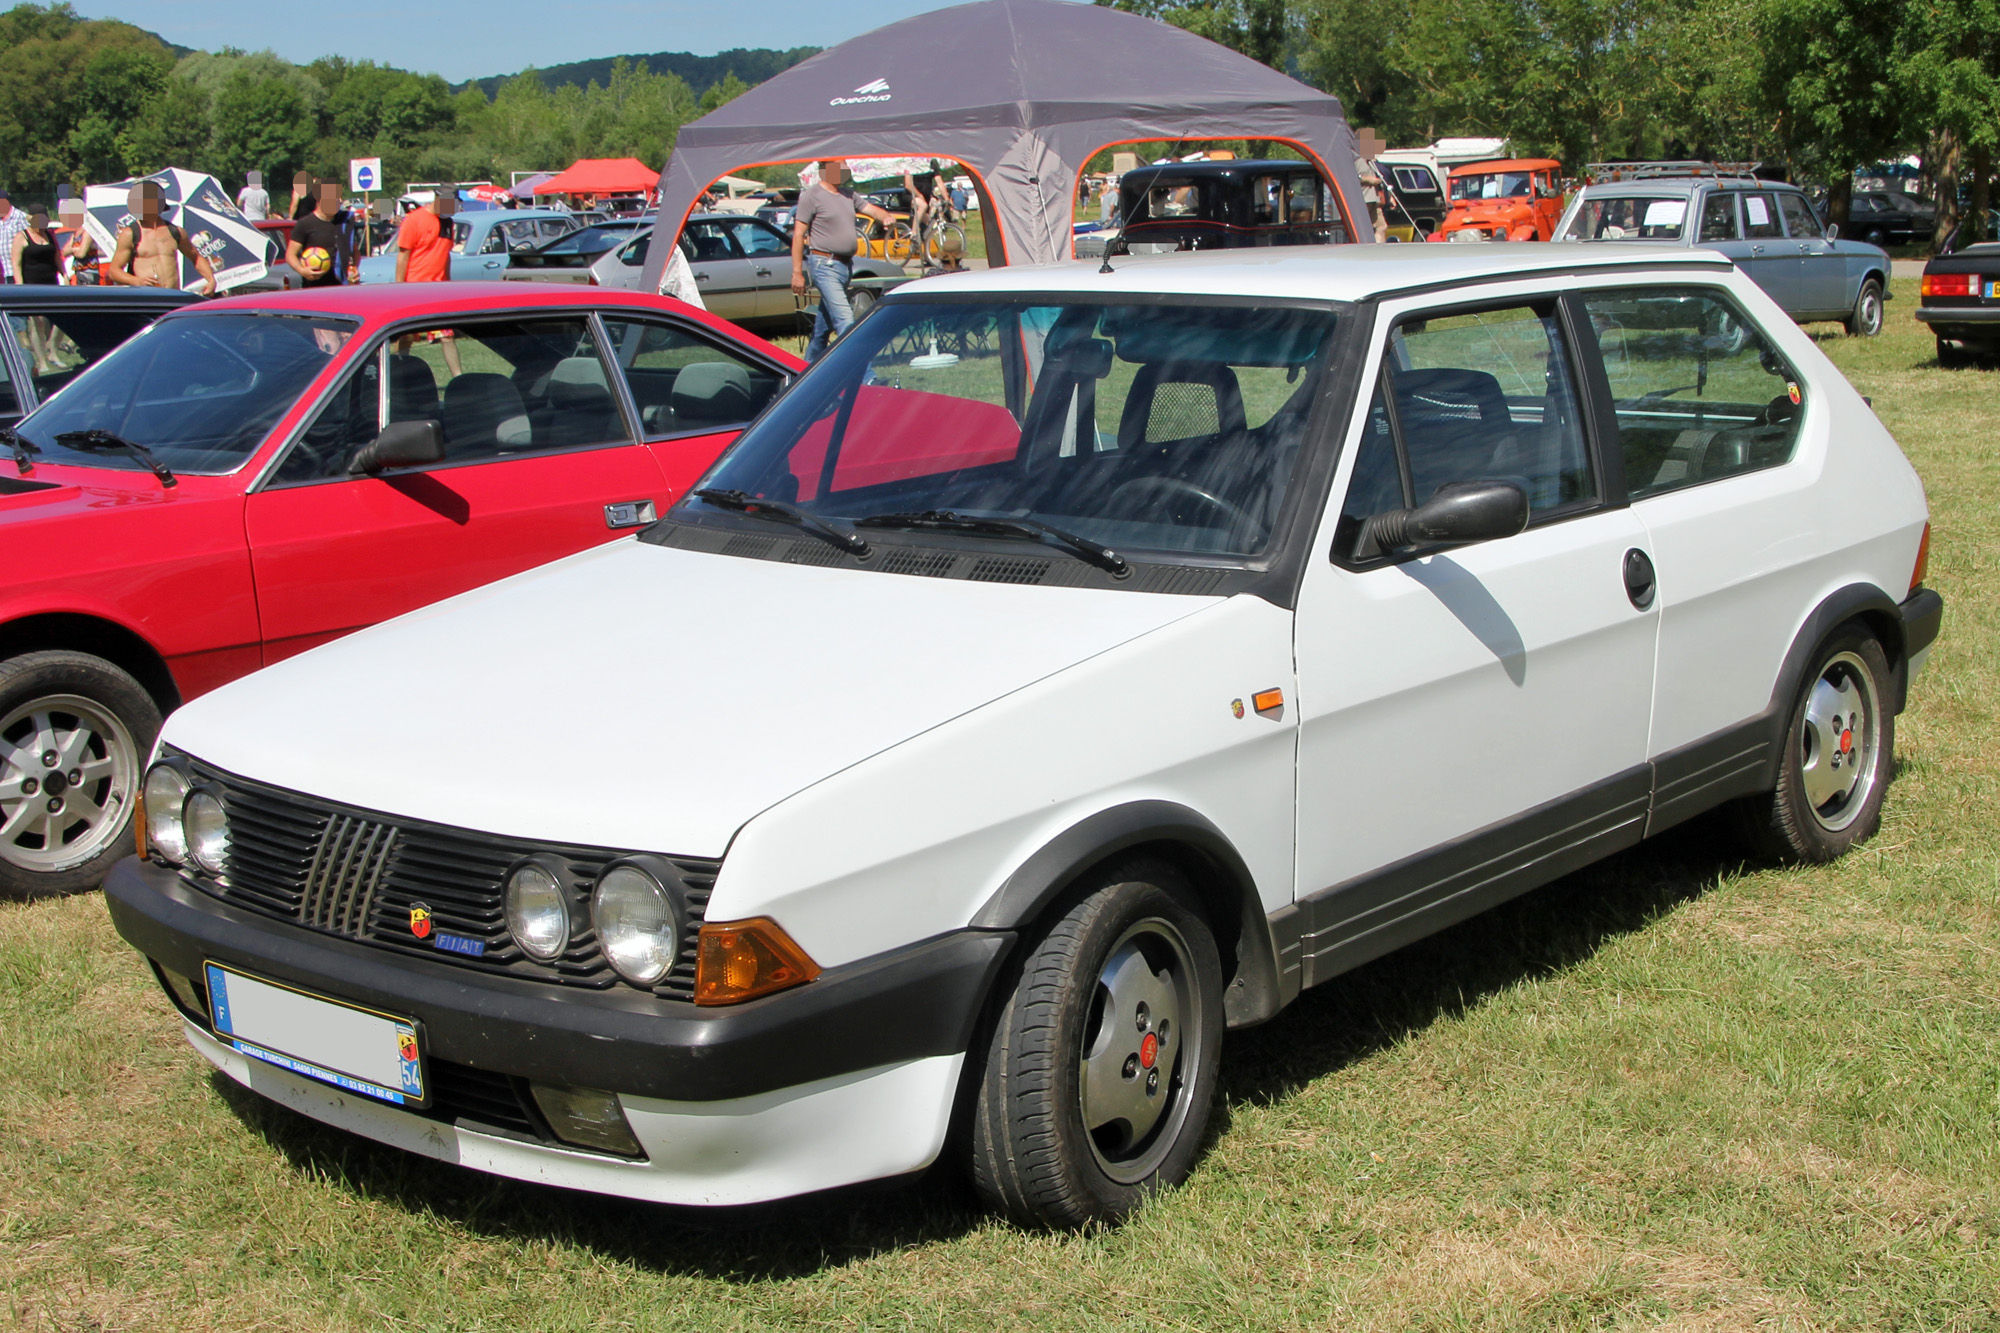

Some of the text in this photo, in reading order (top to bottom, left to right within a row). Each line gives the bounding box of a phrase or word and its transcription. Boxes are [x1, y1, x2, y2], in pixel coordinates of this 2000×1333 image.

[829, 94, 891, 106] Quechua
[438, 935, 482, 953] FIAT
[218, 1005, 225, 1020] F
[240, 1043, 263, 1059] GARAGE
[311, 1067, 338, 1083] PIENNES
[348, 1080, 357, 1089] 03
[358, 1083, 366, 1092] 82
[367, 1085, 375, 1095] 21
[385, 1091, 394, 1100] 45
[401, 1060, 420, 1089] 54
